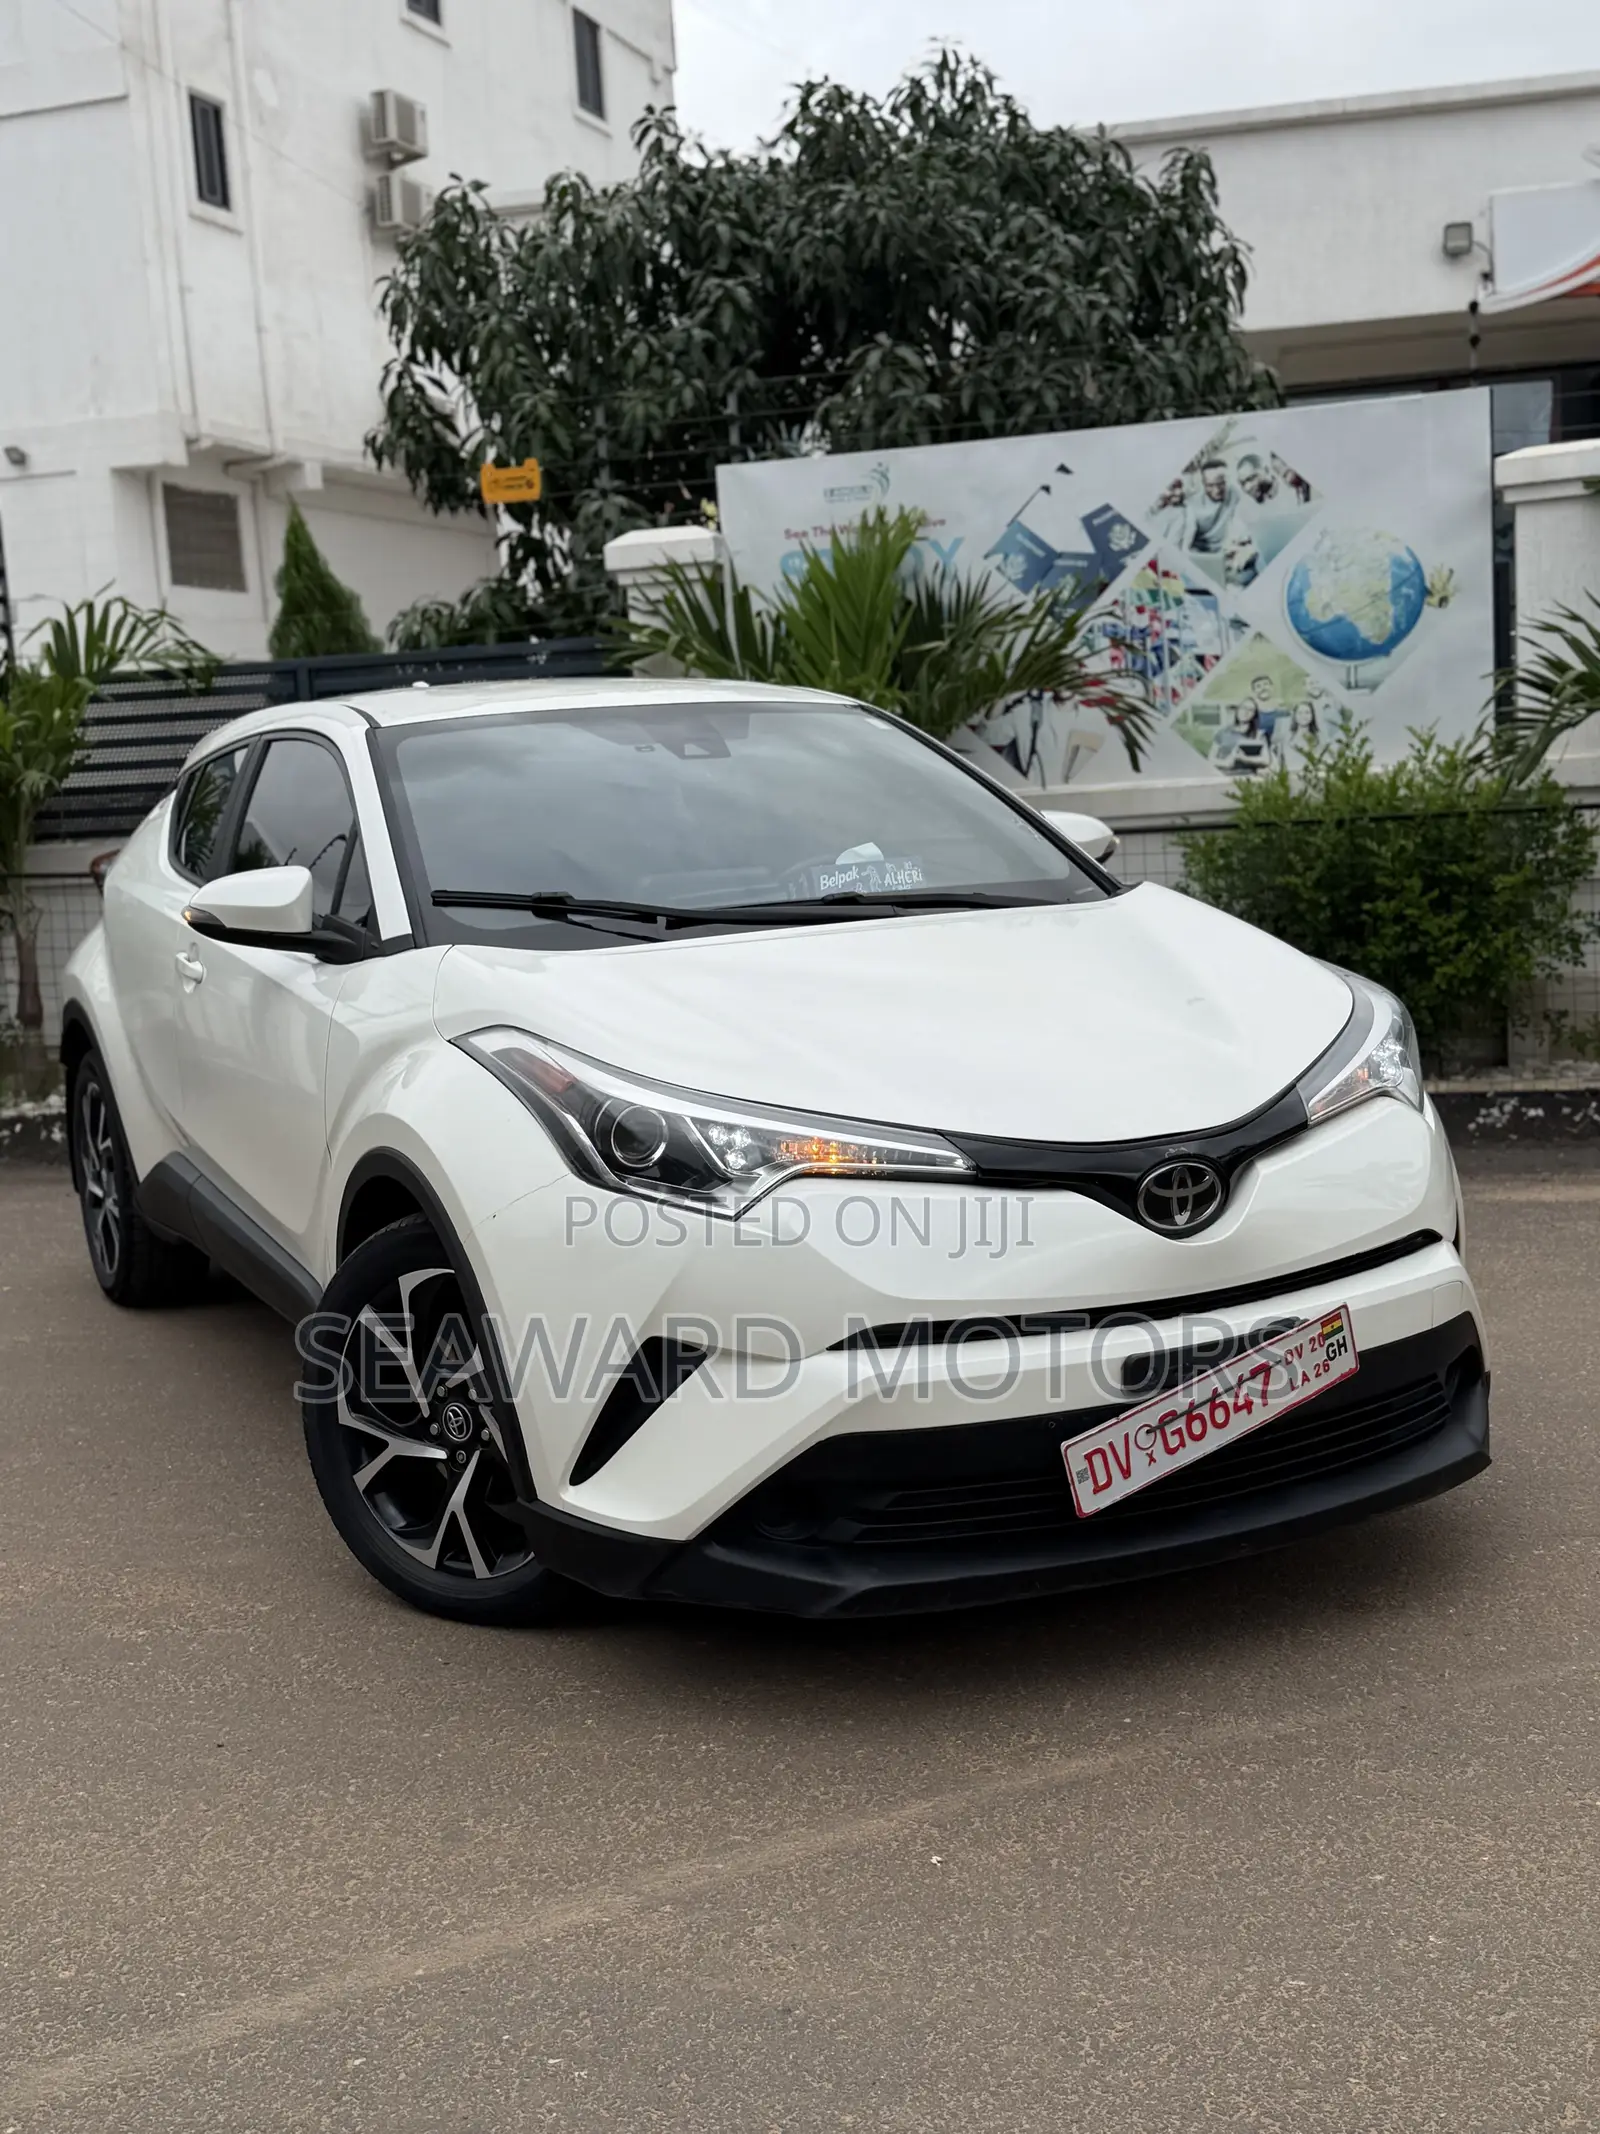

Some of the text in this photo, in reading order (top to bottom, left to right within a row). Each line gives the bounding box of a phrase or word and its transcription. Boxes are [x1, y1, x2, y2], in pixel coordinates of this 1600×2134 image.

[820, 865, 860, 890] Belpak
[1284, 1342, 1304, 1366] DV
[1326, 1335, 1349, 1361] GH
[1313, 1359, 1331, 1379] 26
[1084, 1360, 1272, 1495] DV G6647
